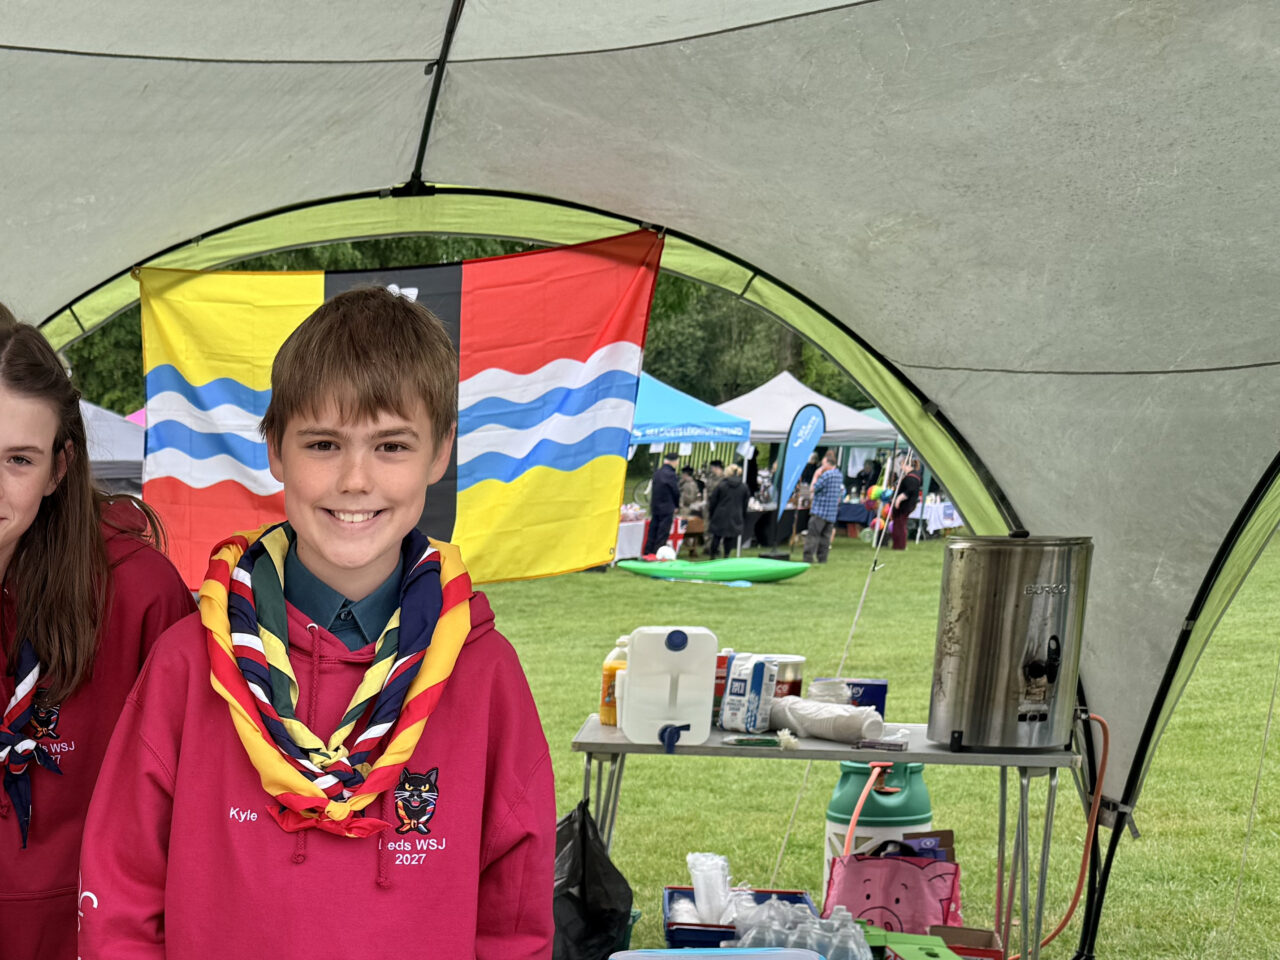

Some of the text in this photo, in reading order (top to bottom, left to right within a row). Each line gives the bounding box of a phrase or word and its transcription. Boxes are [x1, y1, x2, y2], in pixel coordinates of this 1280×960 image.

[50, 741, 75, 753] WSJ
[229, 806, 258, 822] Kyle
[378, 837, 446, 851] eds WSJ
[395, 853, 426, 865] 2027
